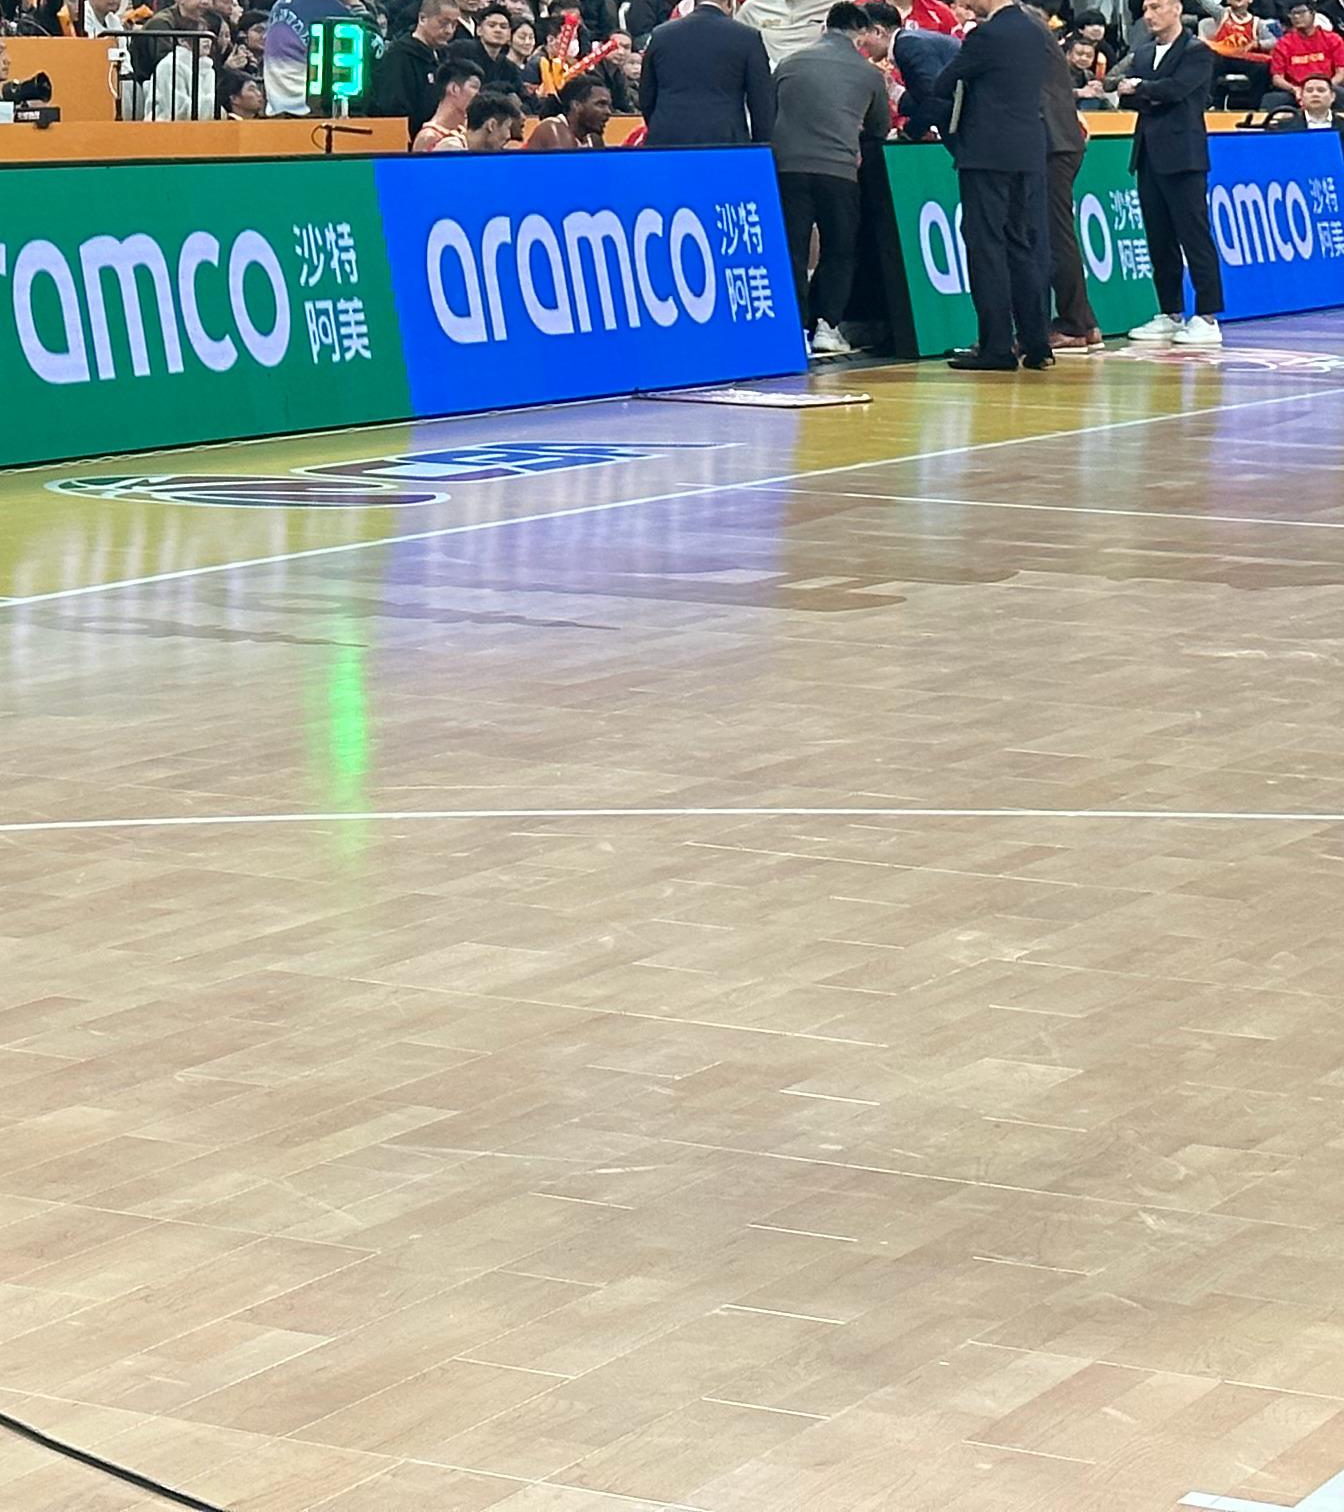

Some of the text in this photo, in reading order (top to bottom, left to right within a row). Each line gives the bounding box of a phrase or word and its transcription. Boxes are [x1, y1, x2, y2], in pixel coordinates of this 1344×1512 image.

[293, 221, 357, 288] 沙特
[715, 201, 764, 257] 沙特
[427, 206, 714, 345] aramco
[725, 267, 776, 322] 阿美
[303, 297, 372, 365] 阿美
